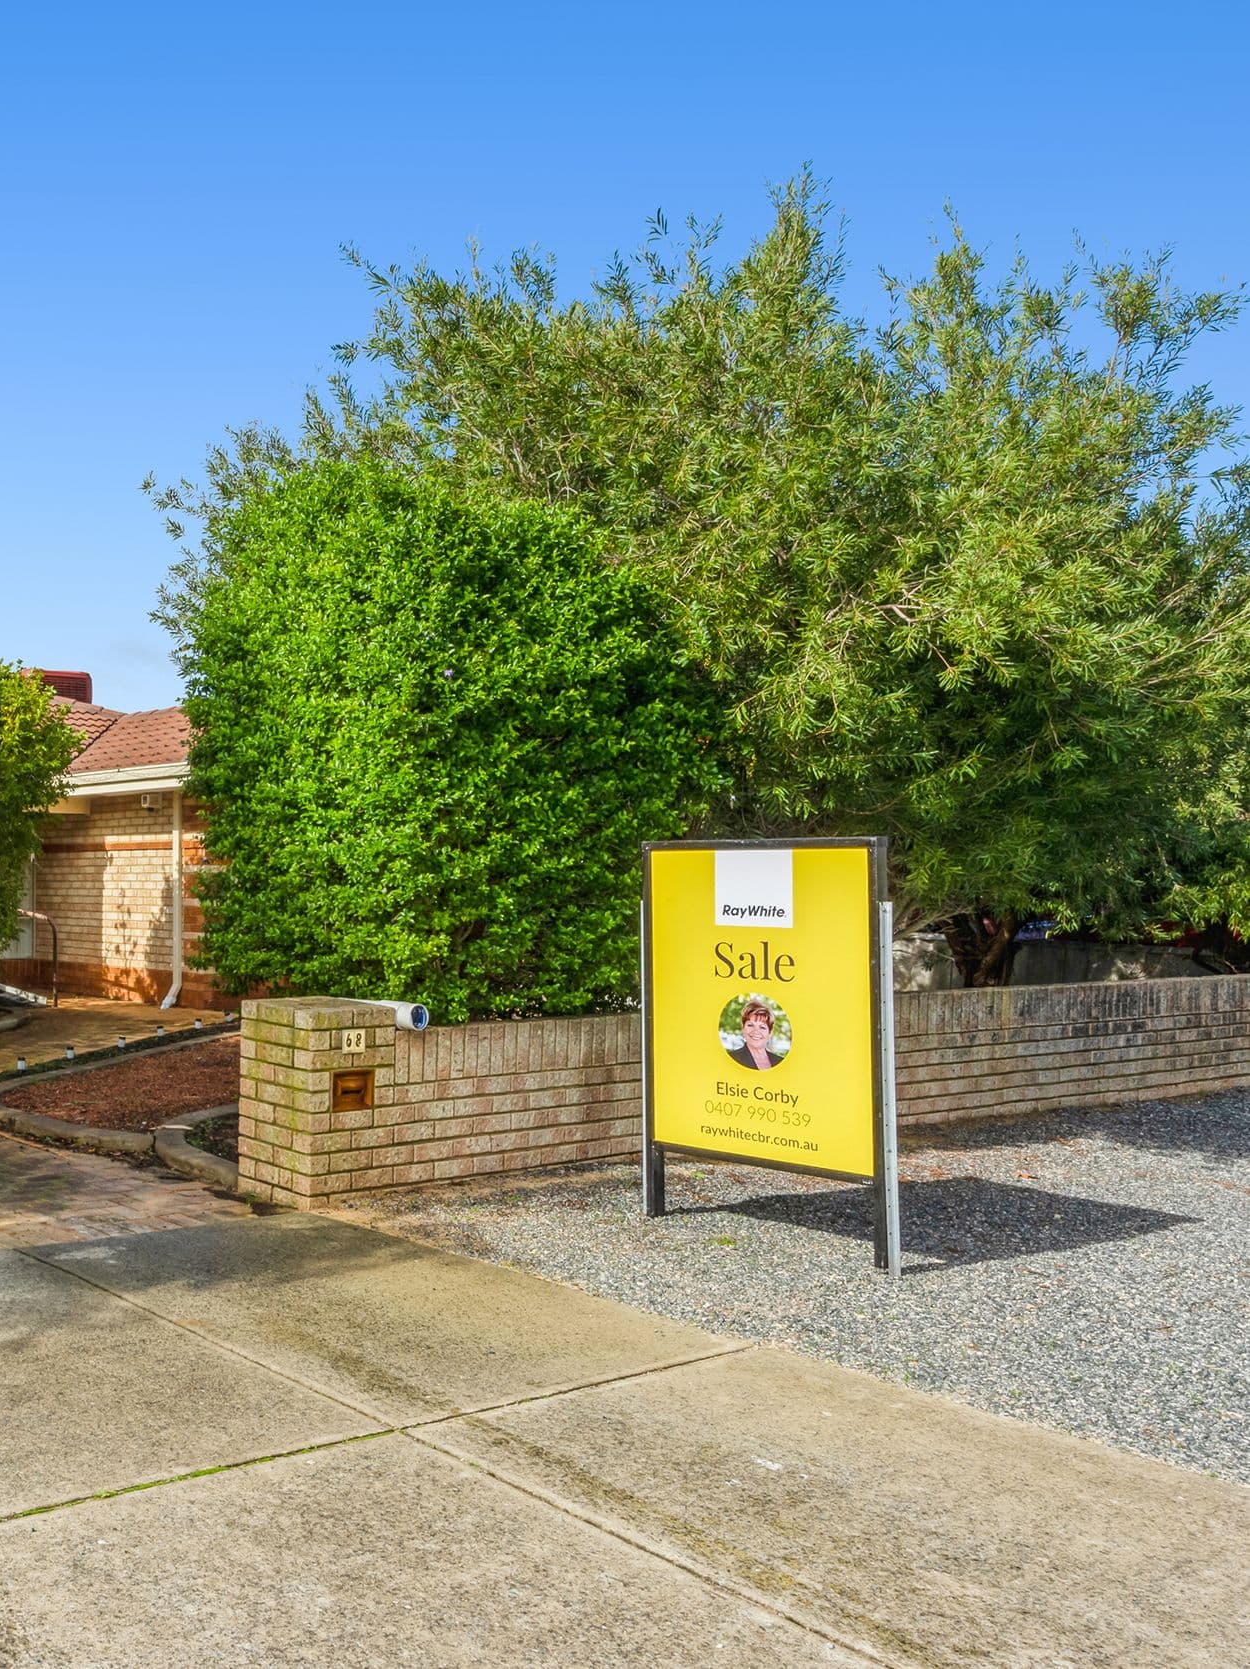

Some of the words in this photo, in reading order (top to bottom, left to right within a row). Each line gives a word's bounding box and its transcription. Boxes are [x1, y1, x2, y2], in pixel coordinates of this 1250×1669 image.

[714, 940, 796, 983] Sale
[345, 1032, 362, 1048] 68
[716, 1081, 749, 1098] Elsie
[753, 1086, 799, 1108] Corby
[704, 1099, 742, 1117] 0407
[747, 1105, 777, 1123] 990
[782, 1110, 811, 1128] 539
[700, 1125, 819, 1152] raywhitecbr.com.au
